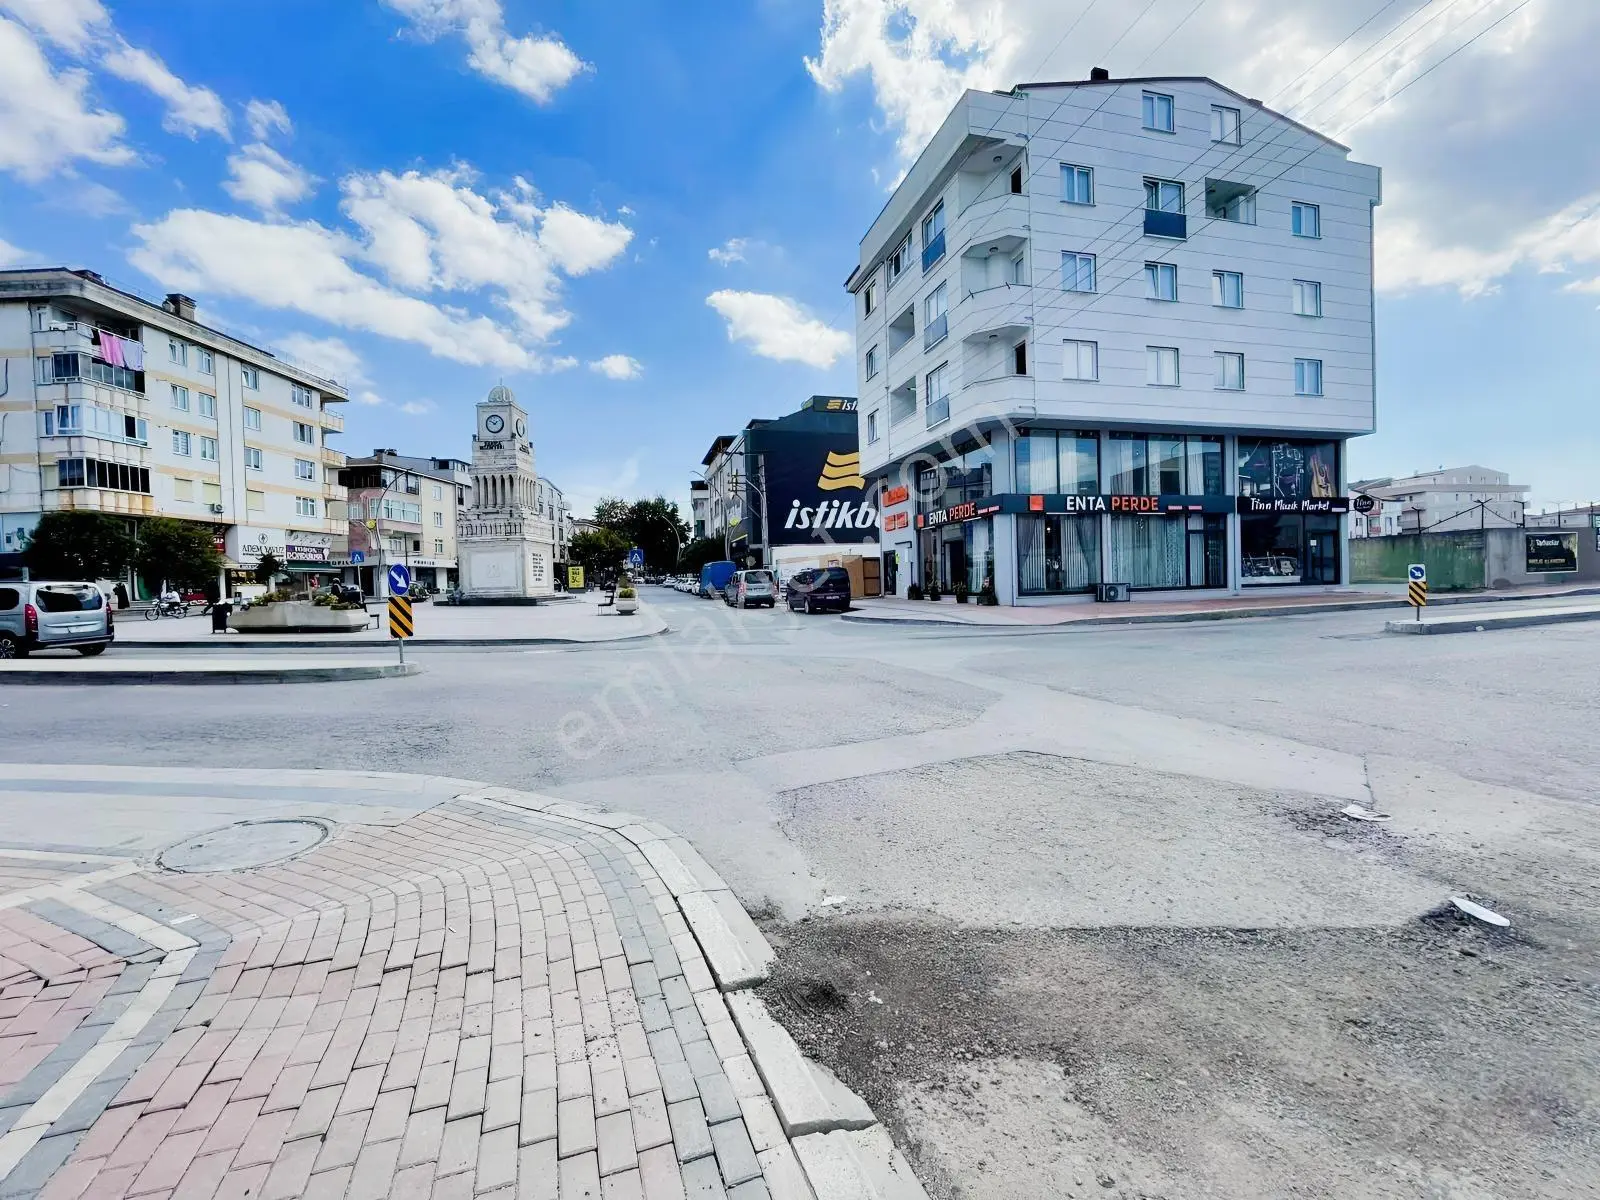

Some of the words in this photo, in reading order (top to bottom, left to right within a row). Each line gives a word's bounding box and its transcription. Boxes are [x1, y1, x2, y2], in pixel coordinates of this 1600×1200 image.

[1066, 496, 1106, 511] ENTA
[1111, 497, 1159, 511] PERDE
[1250, 497, 1272, 511] Tinn
[1301, 499, 1330, 511] Market
[929, 509, 948, 525] ENTA
[949, 502, 976, 521] PERDE
